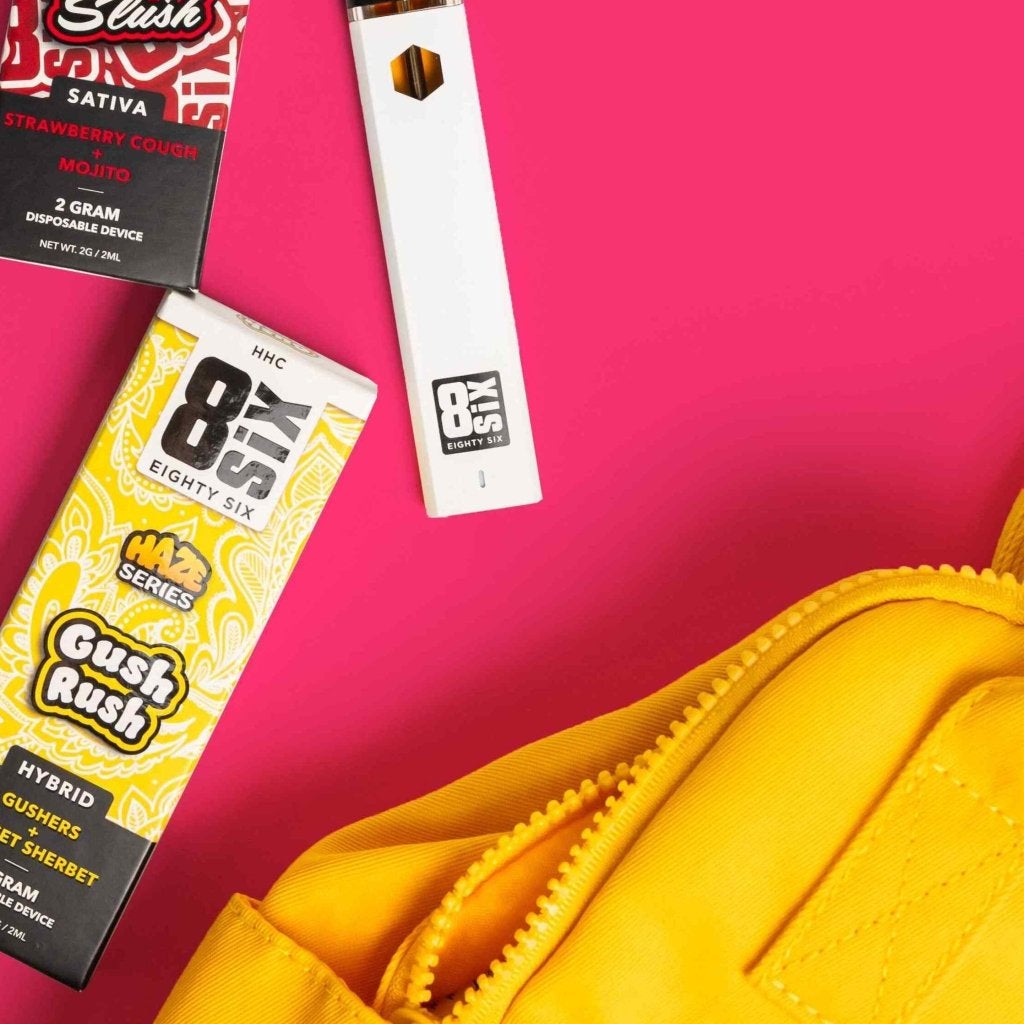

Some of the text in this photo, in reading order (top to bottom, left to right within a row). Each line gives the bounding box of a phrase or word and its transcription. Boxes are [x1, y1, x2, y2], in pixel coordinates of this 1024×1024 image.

[67, 88, 148, 116] SATIVA
[4, 112, 198, 160] STRAWBERRY COUGH
[58, 157, 132, 183] MOJITO
[26, 212, 143, 242] DISPOSABLE DEVICE
[55, 198, 120, 221] 2 GRAM
[39, 240, 59, 250] NET
[58, 242, 77, 254] WT.
[79, 245, 92, 256] 2G
[100, 248, 121, 262] 2ML
[252, 345, 287, 370] HHC
[160, 356, 253, 471] 8
[437, 382, 473, 438] 8
[447, 435, 503, 450] EIGHTY SIX
[150, 460, 255, 520] EIGHTY SIX
[118, 563, 194, 610] SERIES
[125, 534, 210, 592] HAZE
[59, 623, 175, 704] Gush
[47, 666, 147, 740] Rush
[18, 760, 95, 809] HYBRID
[1, 792, 83, 840] GUSHERS
[21, 840, 100, 888] SHERBET
[8, 927, 27, 942] 2ML
[14, 901, 55, 929] DEVICE
